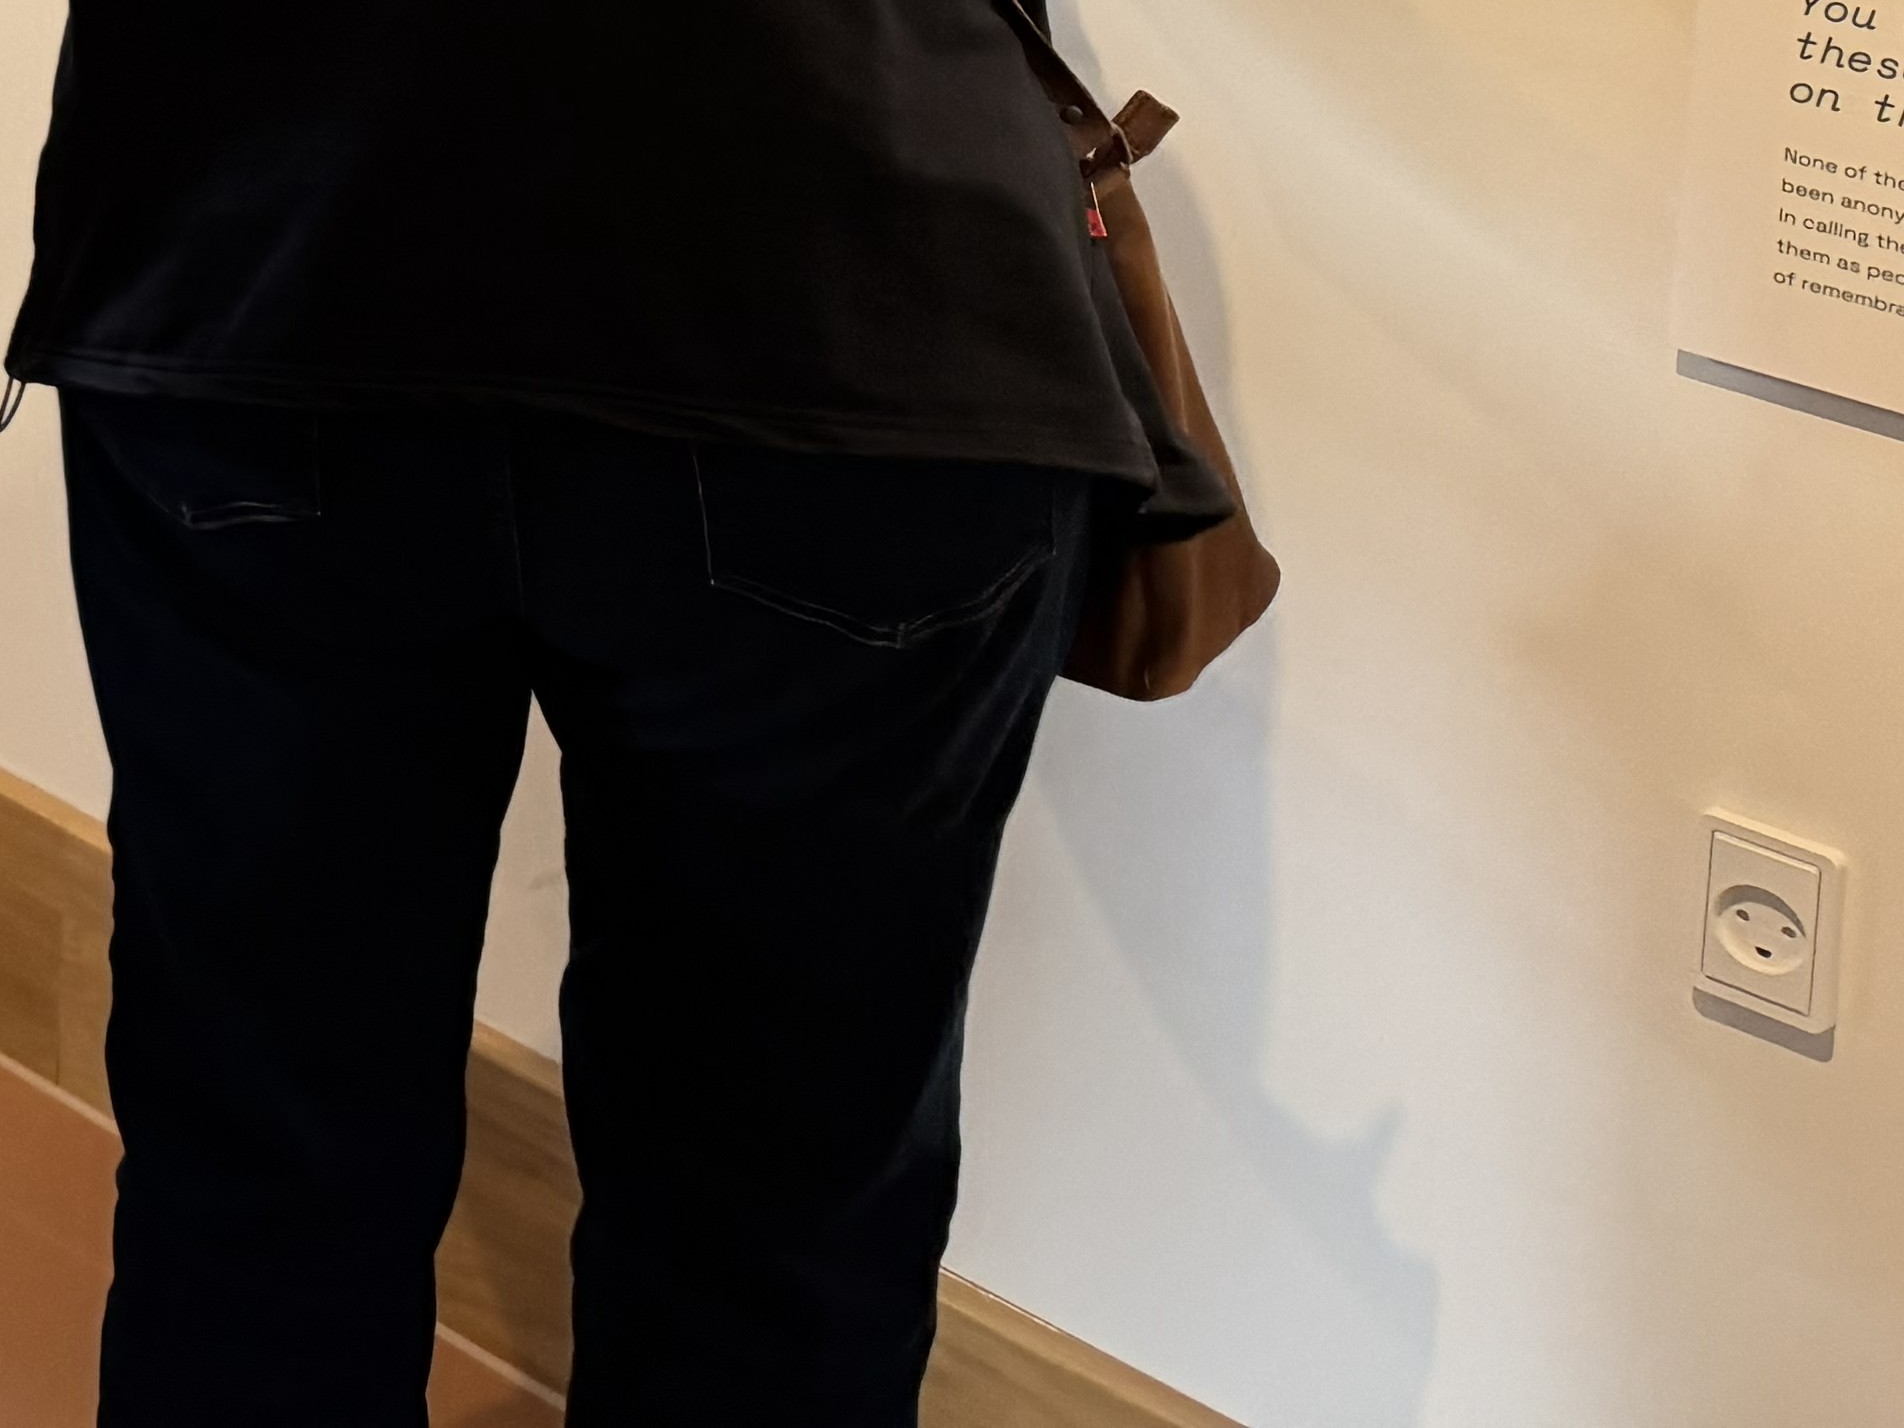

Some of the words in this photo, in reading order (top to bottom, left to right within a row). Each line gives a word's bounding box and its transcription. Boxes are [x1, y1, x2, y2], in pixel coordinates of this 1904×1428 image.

[1797, 32, 1904, 79] thes
[1790, 83, 1840, 111] on
[1784, 147, 1838, 174] None
[1845, 166, 1867, 180] of
[1782, 178, 1834, 204] been
[1841, 196, 1904, 224] anony
[1779, 207, 1796, 225] In
[1803, 217, 1869, 248] calling
[1777, 239, 1830, 265] them
[1837, 258, 1860, 273] as
[1774, 272, 1796, 286] of
